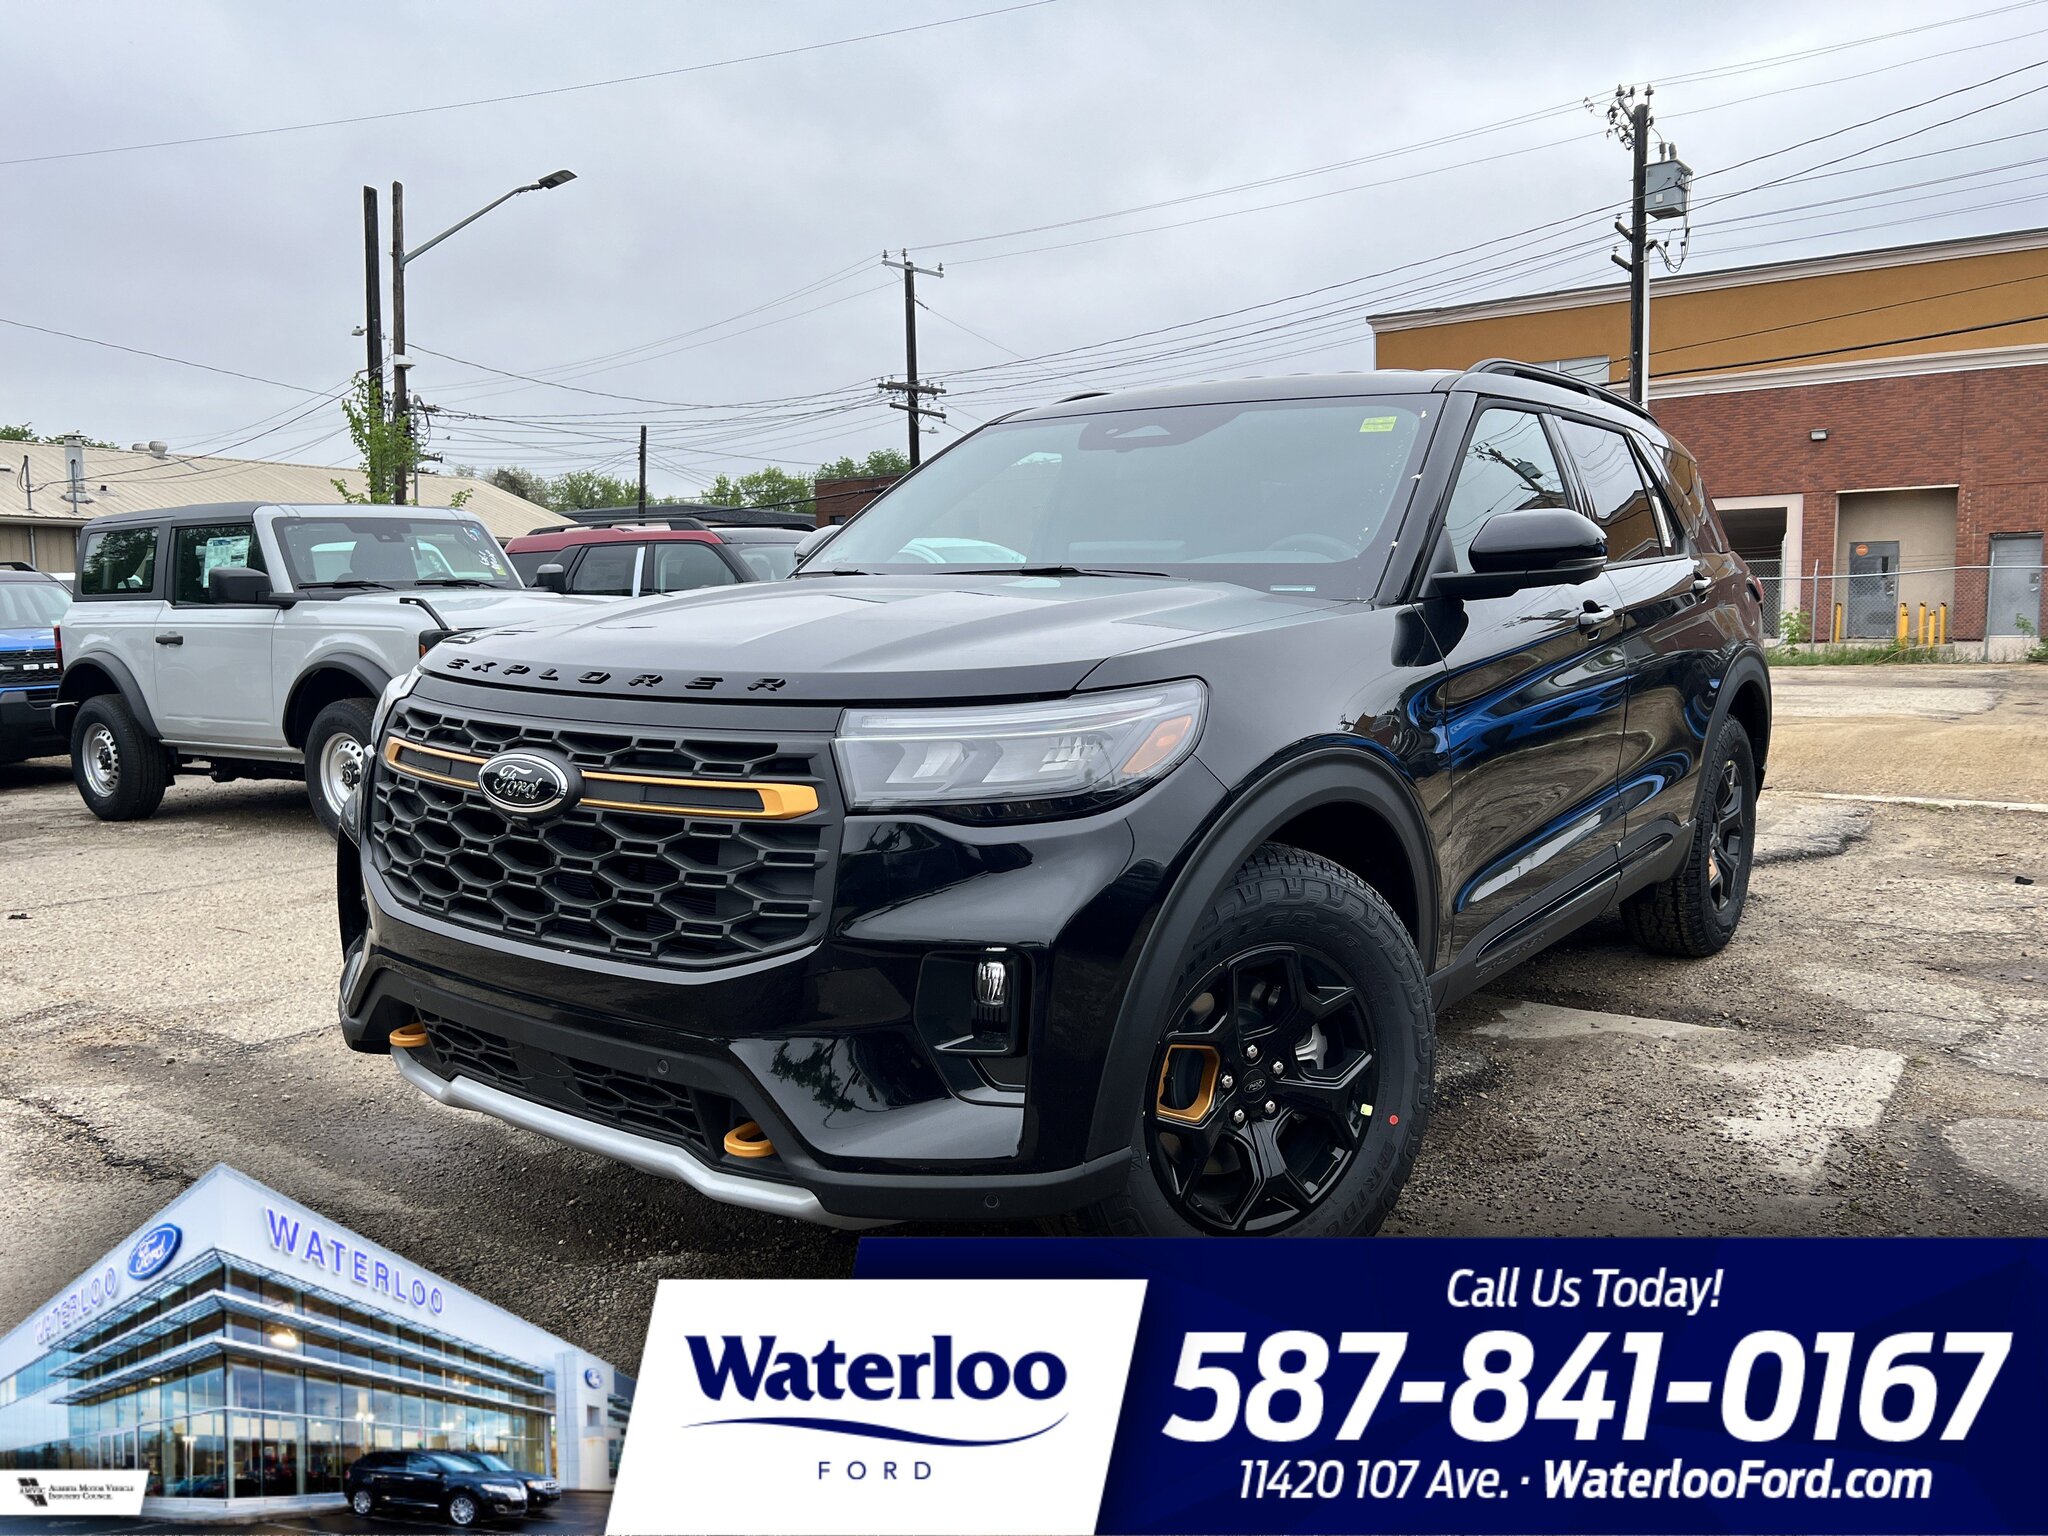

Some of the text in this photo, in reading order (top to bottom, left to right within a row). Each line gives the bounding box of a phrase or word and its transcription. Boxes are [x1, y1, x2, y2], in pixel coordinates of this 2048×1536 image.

[446, 658, 786, 692] EXPLORER
[493, 764, 542, 800] Ford
[1316, 1138, 1397, 1238] BRIDG
